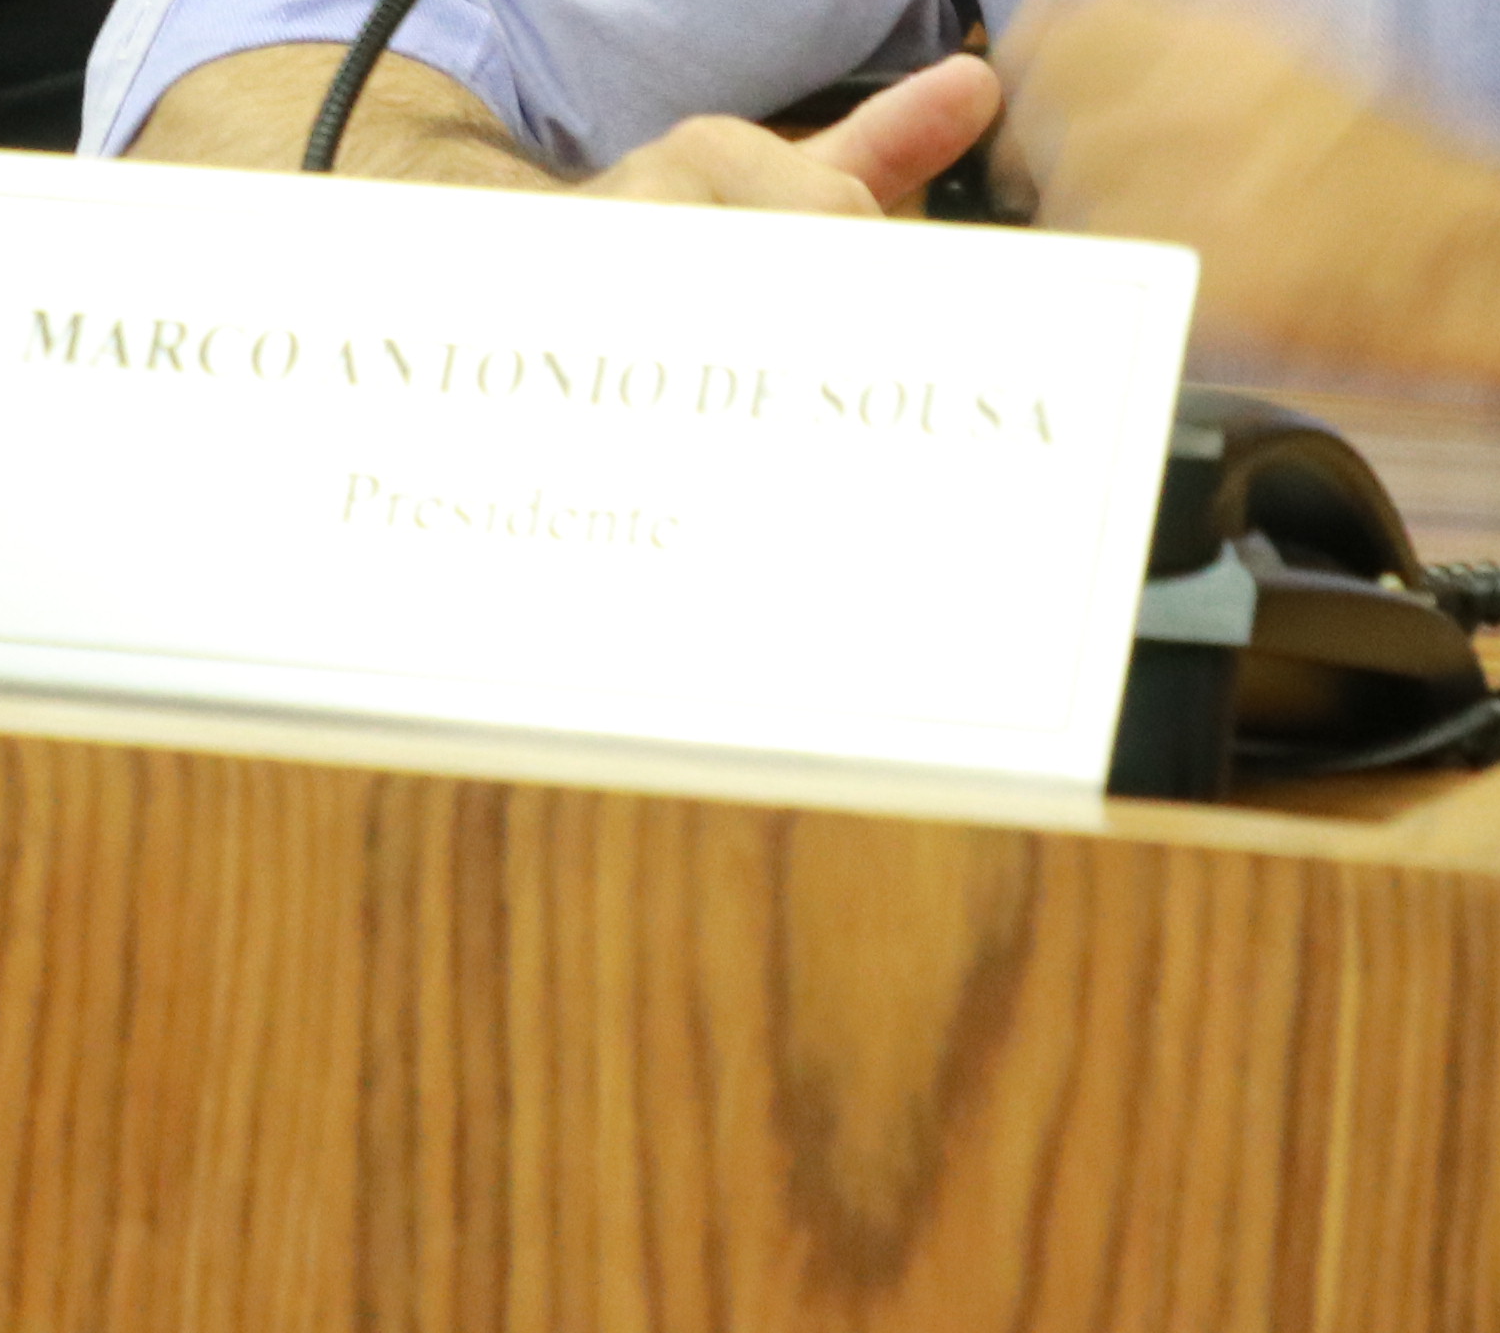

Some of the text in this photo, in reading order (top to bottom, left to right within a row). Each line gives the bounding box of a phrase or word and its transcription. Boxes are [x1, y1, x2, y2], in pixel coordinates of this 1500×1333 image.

[18, 305, 1058, 447] MARCO ANTONIO DE SOUSA
[334, 469, 686, 555] Presidente
